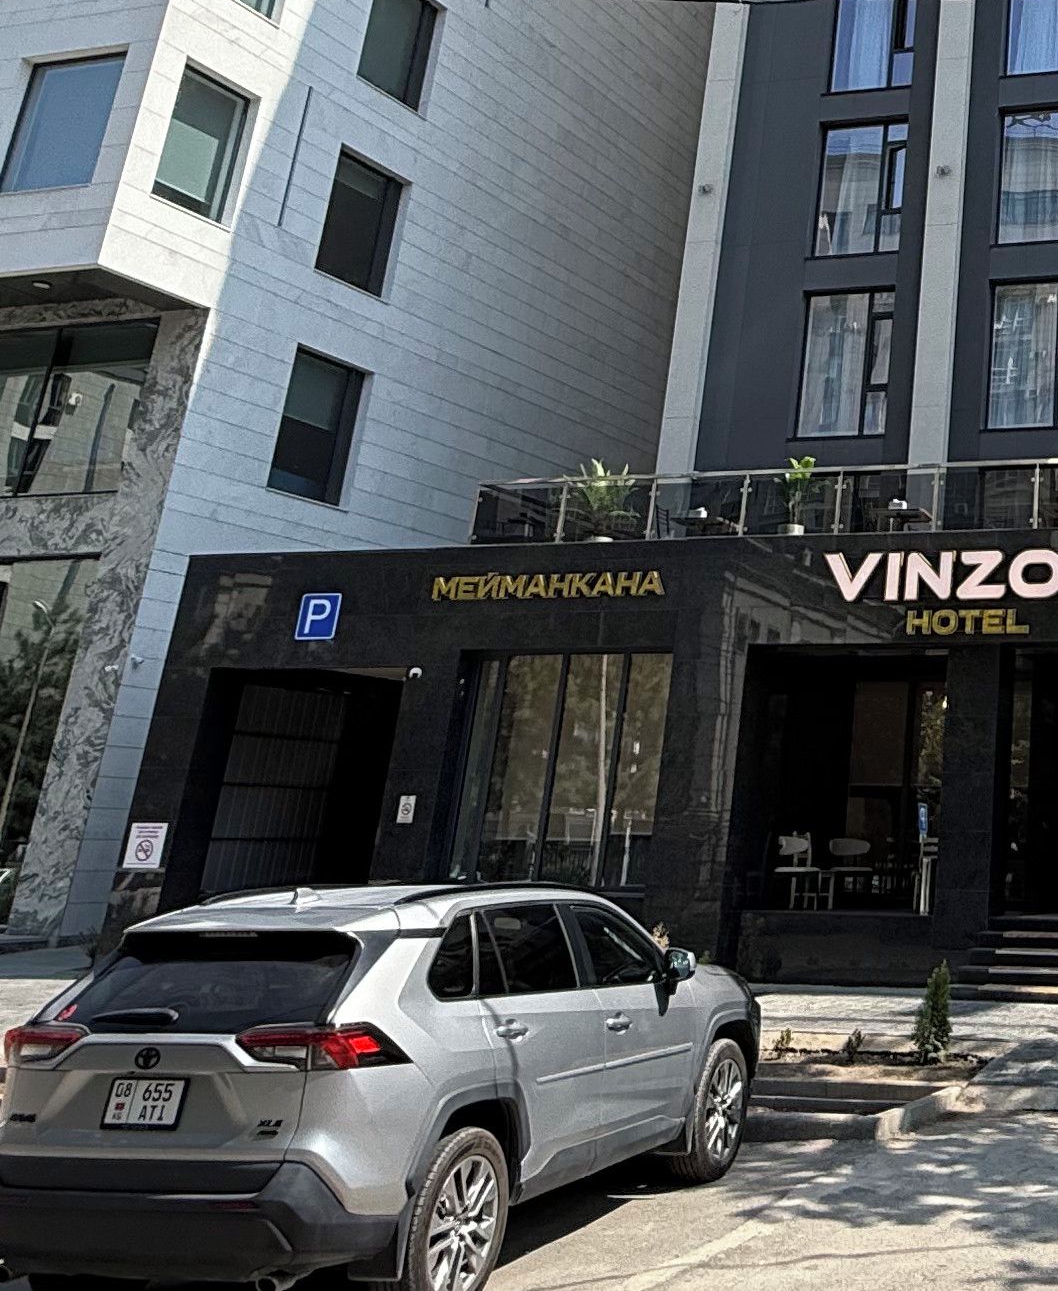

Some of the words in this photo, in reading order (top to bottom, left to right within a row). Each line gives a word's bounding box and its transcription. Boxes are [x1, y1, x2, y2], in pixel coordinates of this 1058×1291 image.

[431, 571, 665, 601] МЕЙМАНКАНА
[303, 598, 331, 634] P
[905, 608, 1030, 635] HOTEL
[115, 1082, 132, 1097] 08
[142, 1082, 175, 1102] 655
